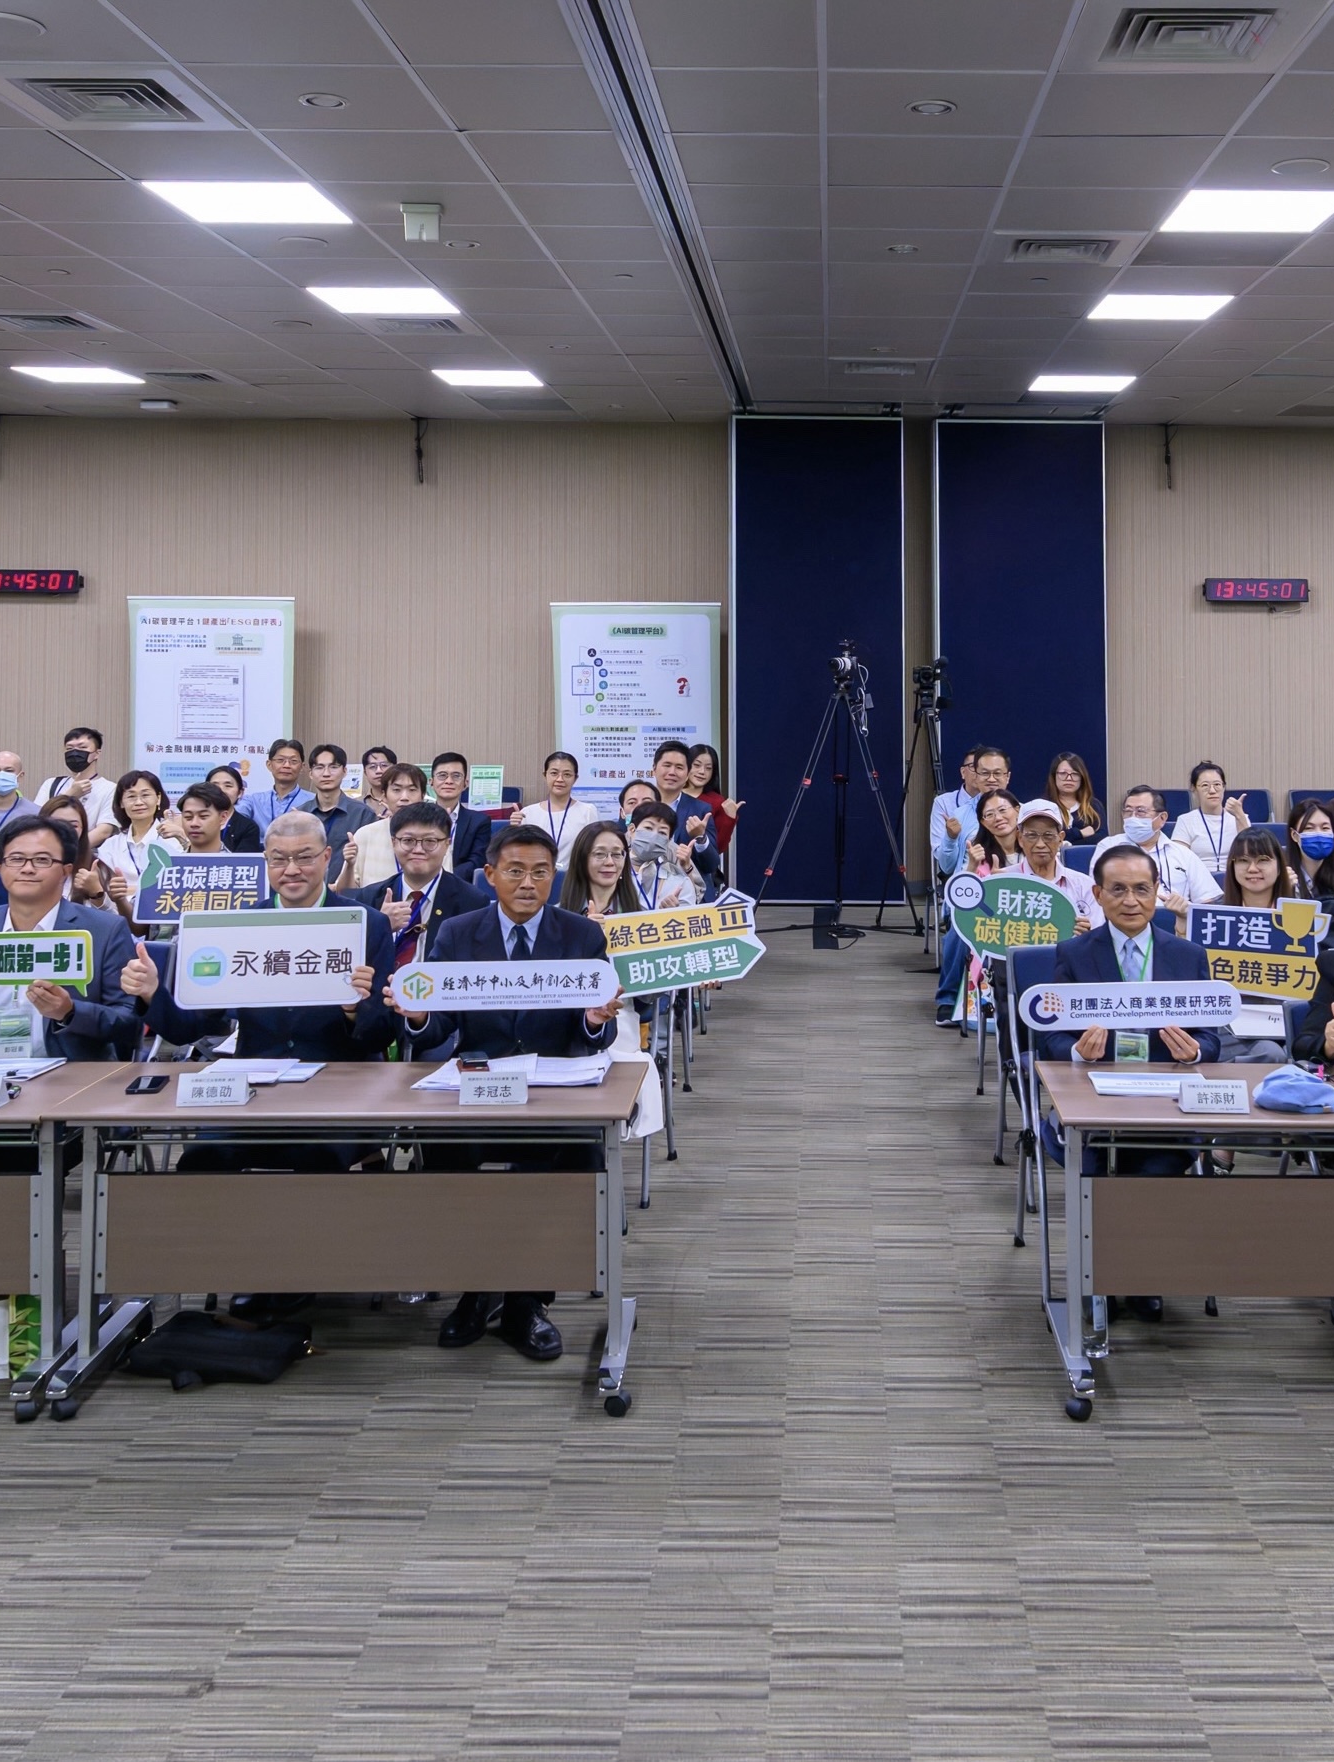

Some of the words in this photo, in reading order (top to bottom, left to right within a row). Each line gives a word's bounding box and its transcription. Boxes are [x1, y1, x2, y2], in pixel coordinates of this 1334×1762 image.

[1216, 581, 1306, 599] 13:45:01
[156, 865, 259, 890] 低碳轉型
[155, 890, 259, 913] 永續同行
[997, 889, 1053, 920] 財務
[609, 914, 714, 949] 綠色金融
[974, 917, 1059, 946] 碳健檢
[1201, 912, 1273, 949] 打造
[230, 947, 353, 977] 永續金融
[628, 944, 741, 985] 助攻轉型
[1211, 957, 1317, 991] 色競爭力
[1070, 995, 1232, 1011] 財團法人商業發展研究院
[1070, 1011, 1111, 1019] Commerce
[1112, 1010, 1164, 1019] Development
[1165, 1009, 1200, 1017] Research
[1200, 1008, 1233, 1016] Institute
[473, 1085, 512, 1098] 李冠志
[1197, 1092, 1235, 1105] 許添財
